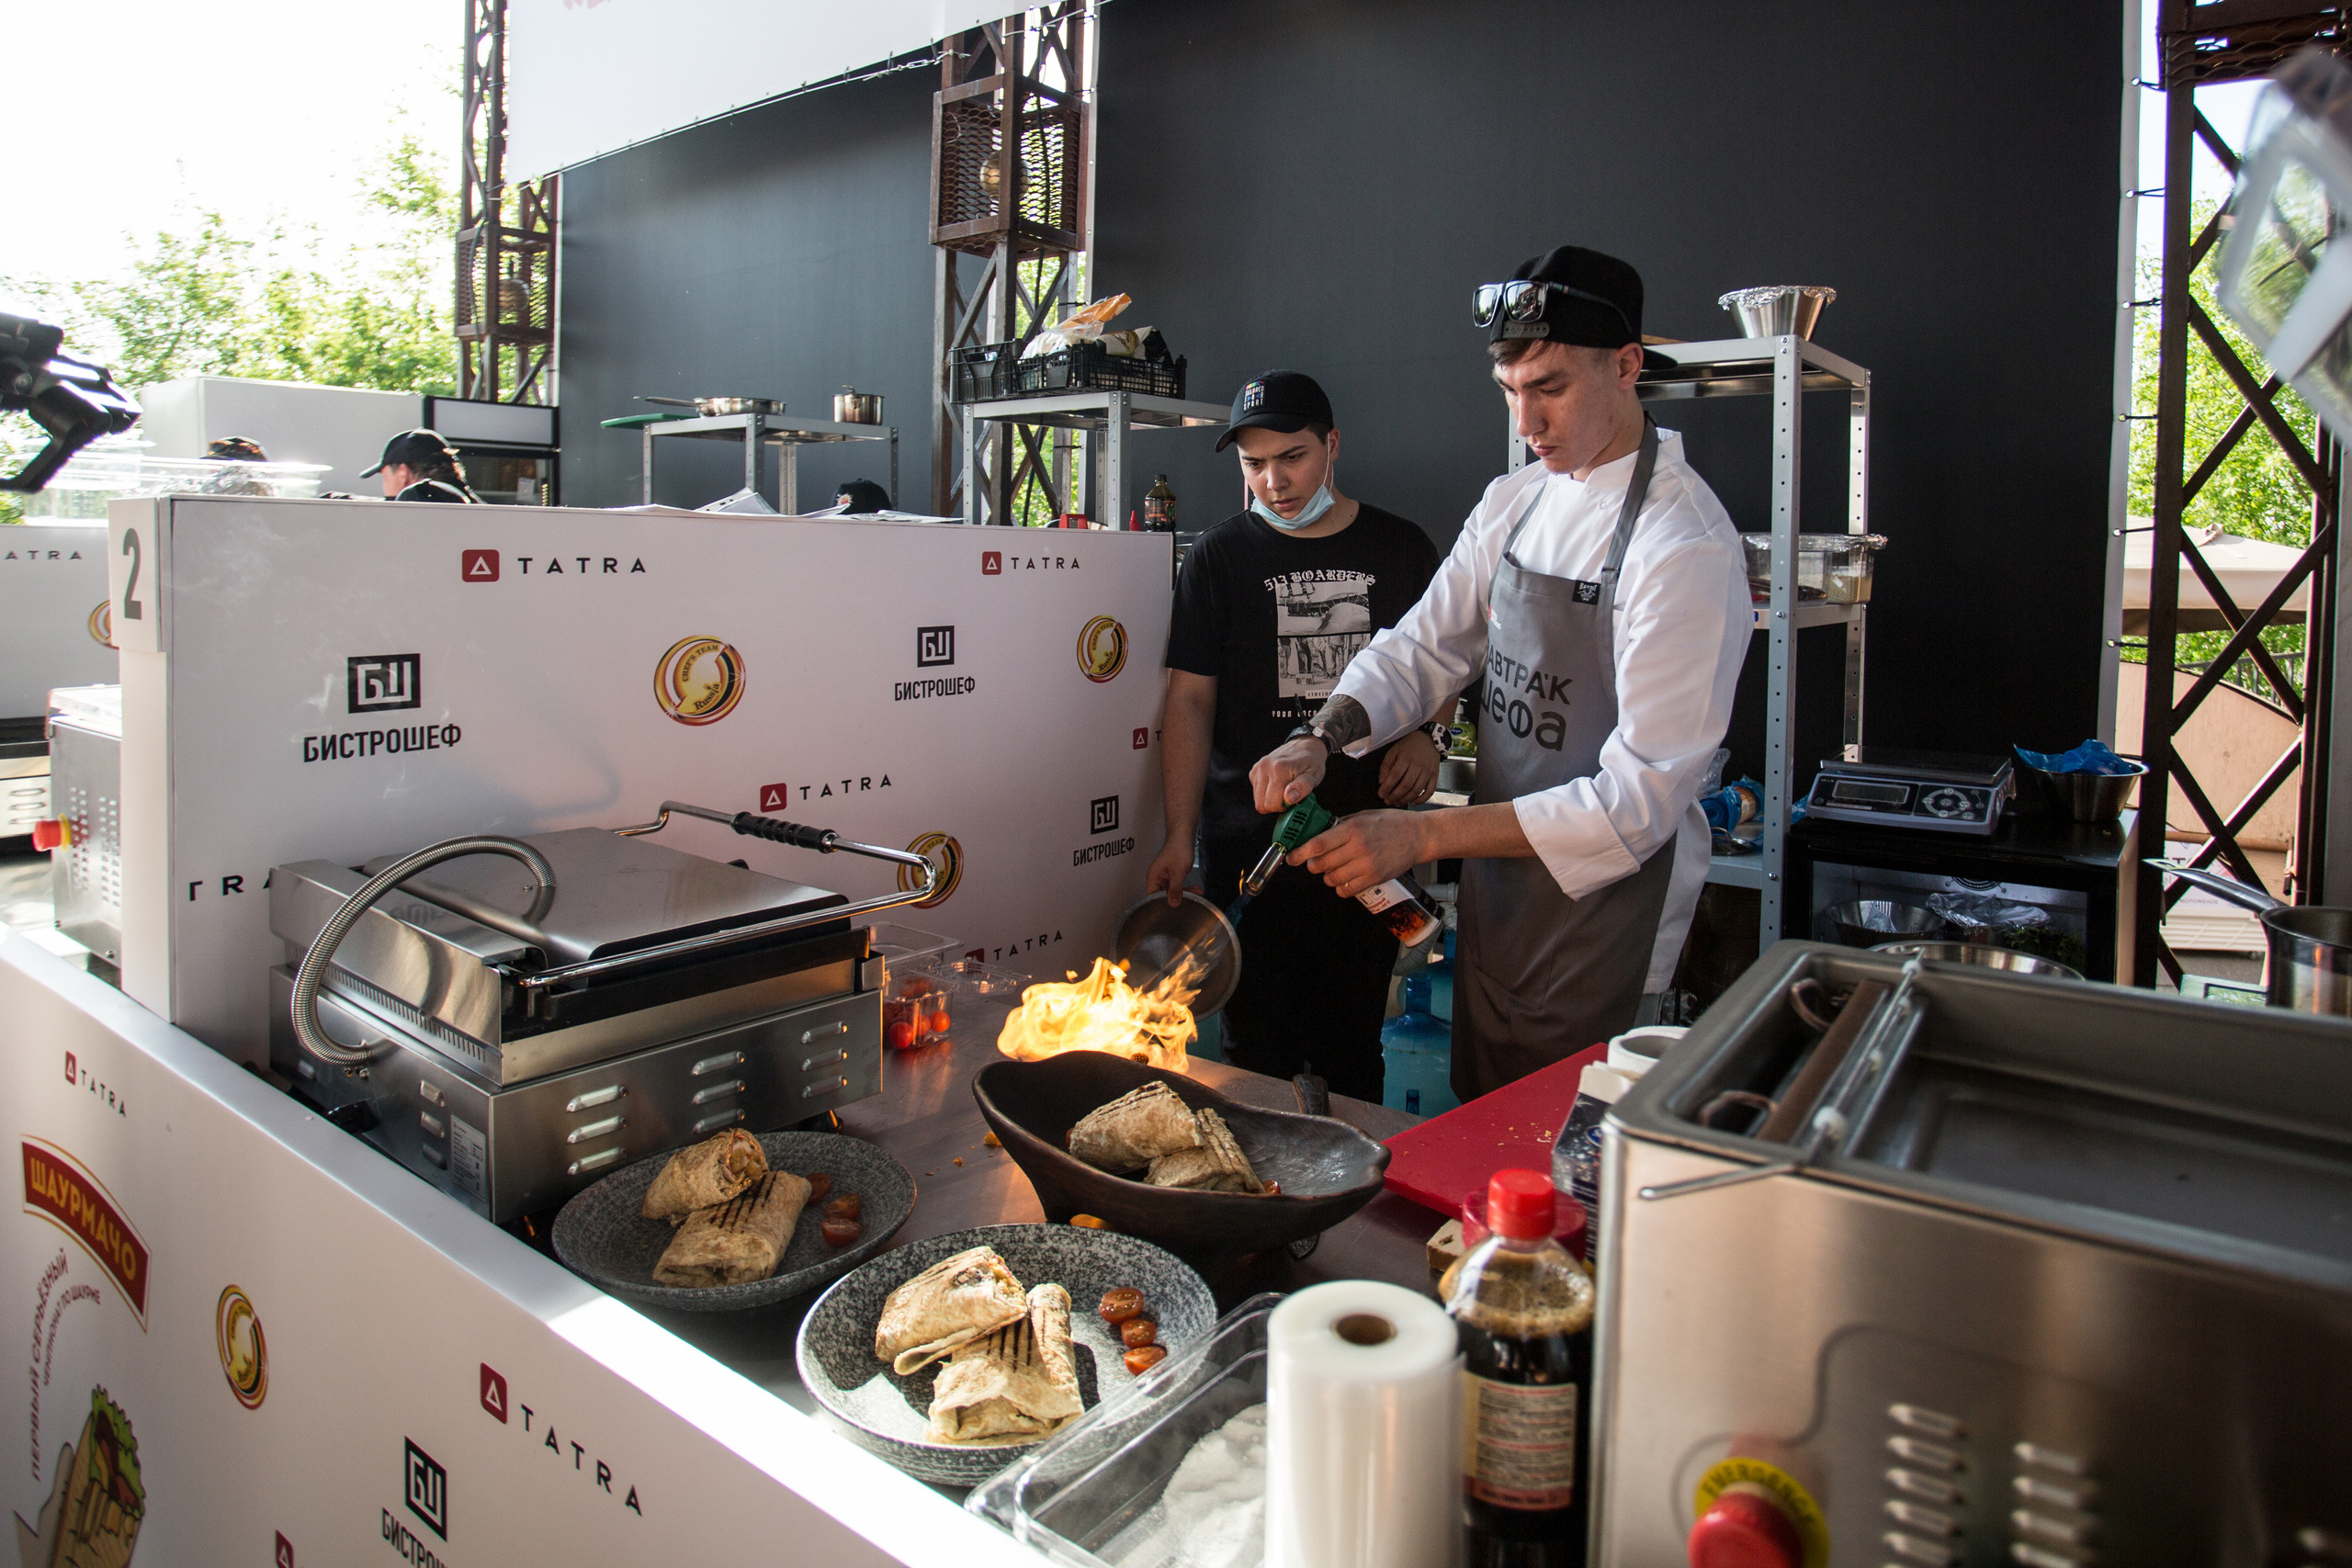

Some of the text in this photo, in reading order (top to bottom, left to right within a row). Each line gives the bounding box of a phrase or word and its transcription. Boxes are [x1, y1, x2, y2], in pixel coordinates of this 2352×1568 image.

[1243, 399, 1263, 411] SPORT
[123, 527, 141, 620] 2
[517, 557, 646, 574] TATRA
[1011, 557, 1080, 570] TATRA
[1289, 570, 1376, 586] BOARDERS
[695, 645, 718, 655] TEAM
[895, 676, 976, 701] БИСТРОШЕФ
[1487, 644, 1574, 705] АВТРАК
[694, 683, 719, 710] Russia
[303, 724, 461, 763] БИСТРОШЕФ
[799, 773, 891, 800] TATRA
[1073, 837, 1135, 867] БИСТРОШЕФ
[993, 930, 1062, 961] TATRA
[80, 1069, 126, 1117] TATRA
[30, 1156, 137, 1280] ШАУРМАЧО
[521, 1403, 642, 1517] TATRA
[382, 1507, 448, 1568] БИСТРО
